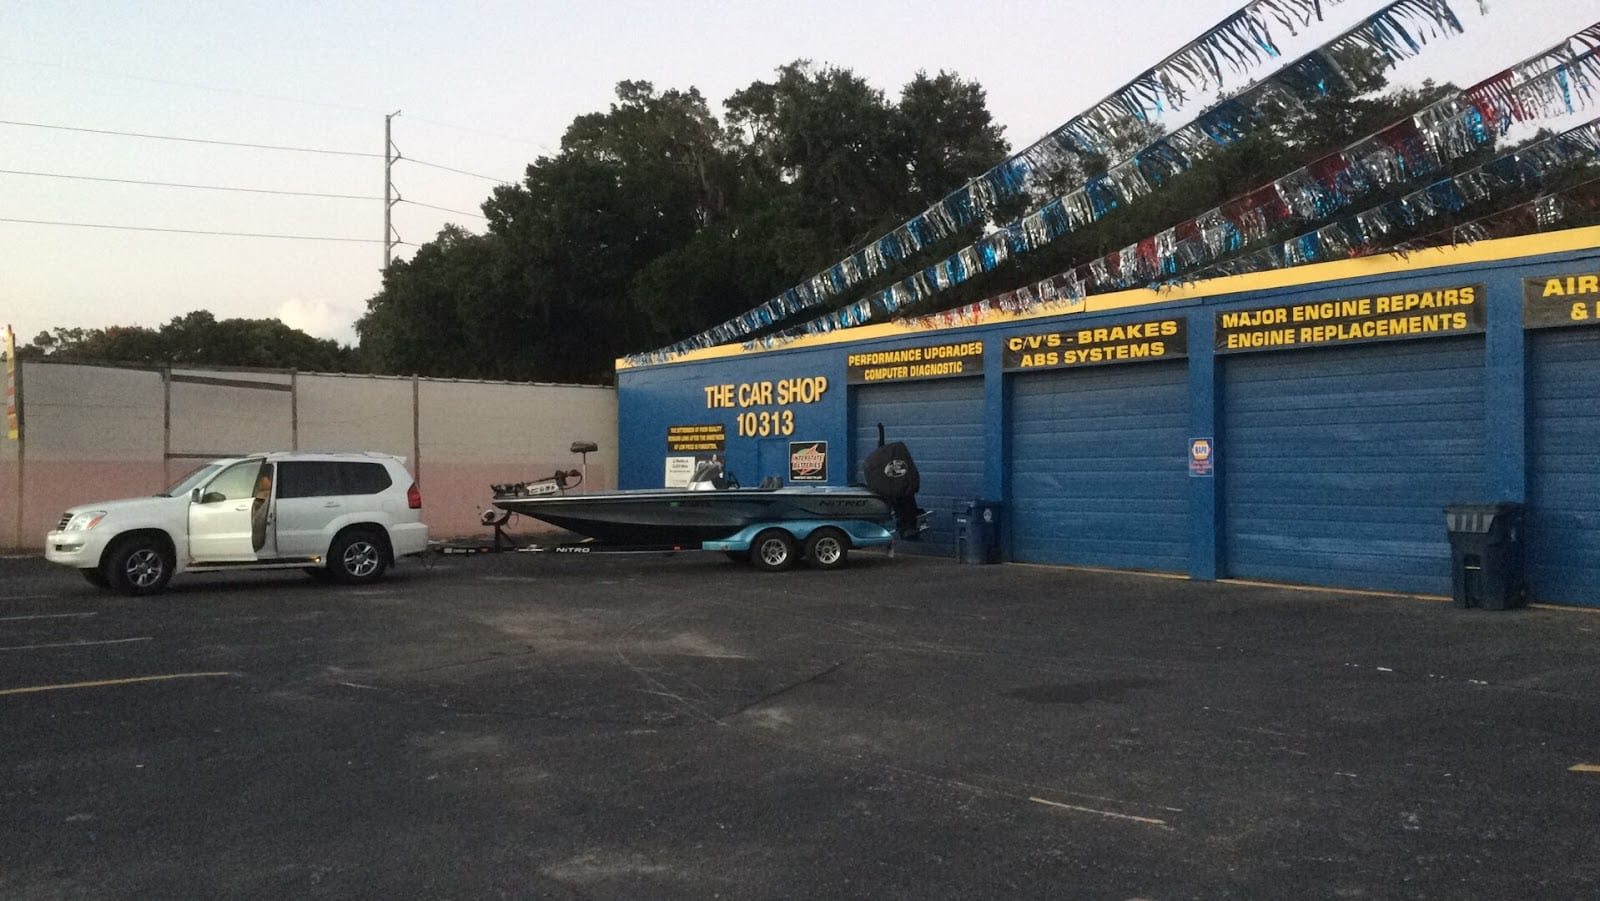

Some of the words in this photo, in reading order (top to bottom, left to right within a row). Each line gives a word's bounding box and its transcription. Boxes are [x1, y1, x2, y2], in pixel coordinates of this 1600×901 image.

[1542, 275, 1599, 297] AIR
[1222, 308, 1288, 329] MAJOR
[1292, 299, 1370, 323] ENGINE
[1376, 287, 1475, 313] REPAIRS
[1570, 302, 1589, 321] &
[1077, 320, 1178, 345] BRAKES
[1227, 328, 1296, 349] ENGINE
[1299, 311, 1468, 344] REPLACEMENTS
[848, 348, 922, 367] PERFORMANCE
[923, 342, 983, 360] UPGRADES
[1020, 351, 1059, 368] ABS
[1063, 341, 1165, 365] SYSTEMS
[864, 367, 909, 381] COMPUTER
[909, 360, 963, 378] DIAGNOSTIC
[704, 383, 736, 409] THE
[738, 381, 773, 408] CAR
[777, 376, 828, 406] SHOP
[737, 409, 795, 437] 10313
